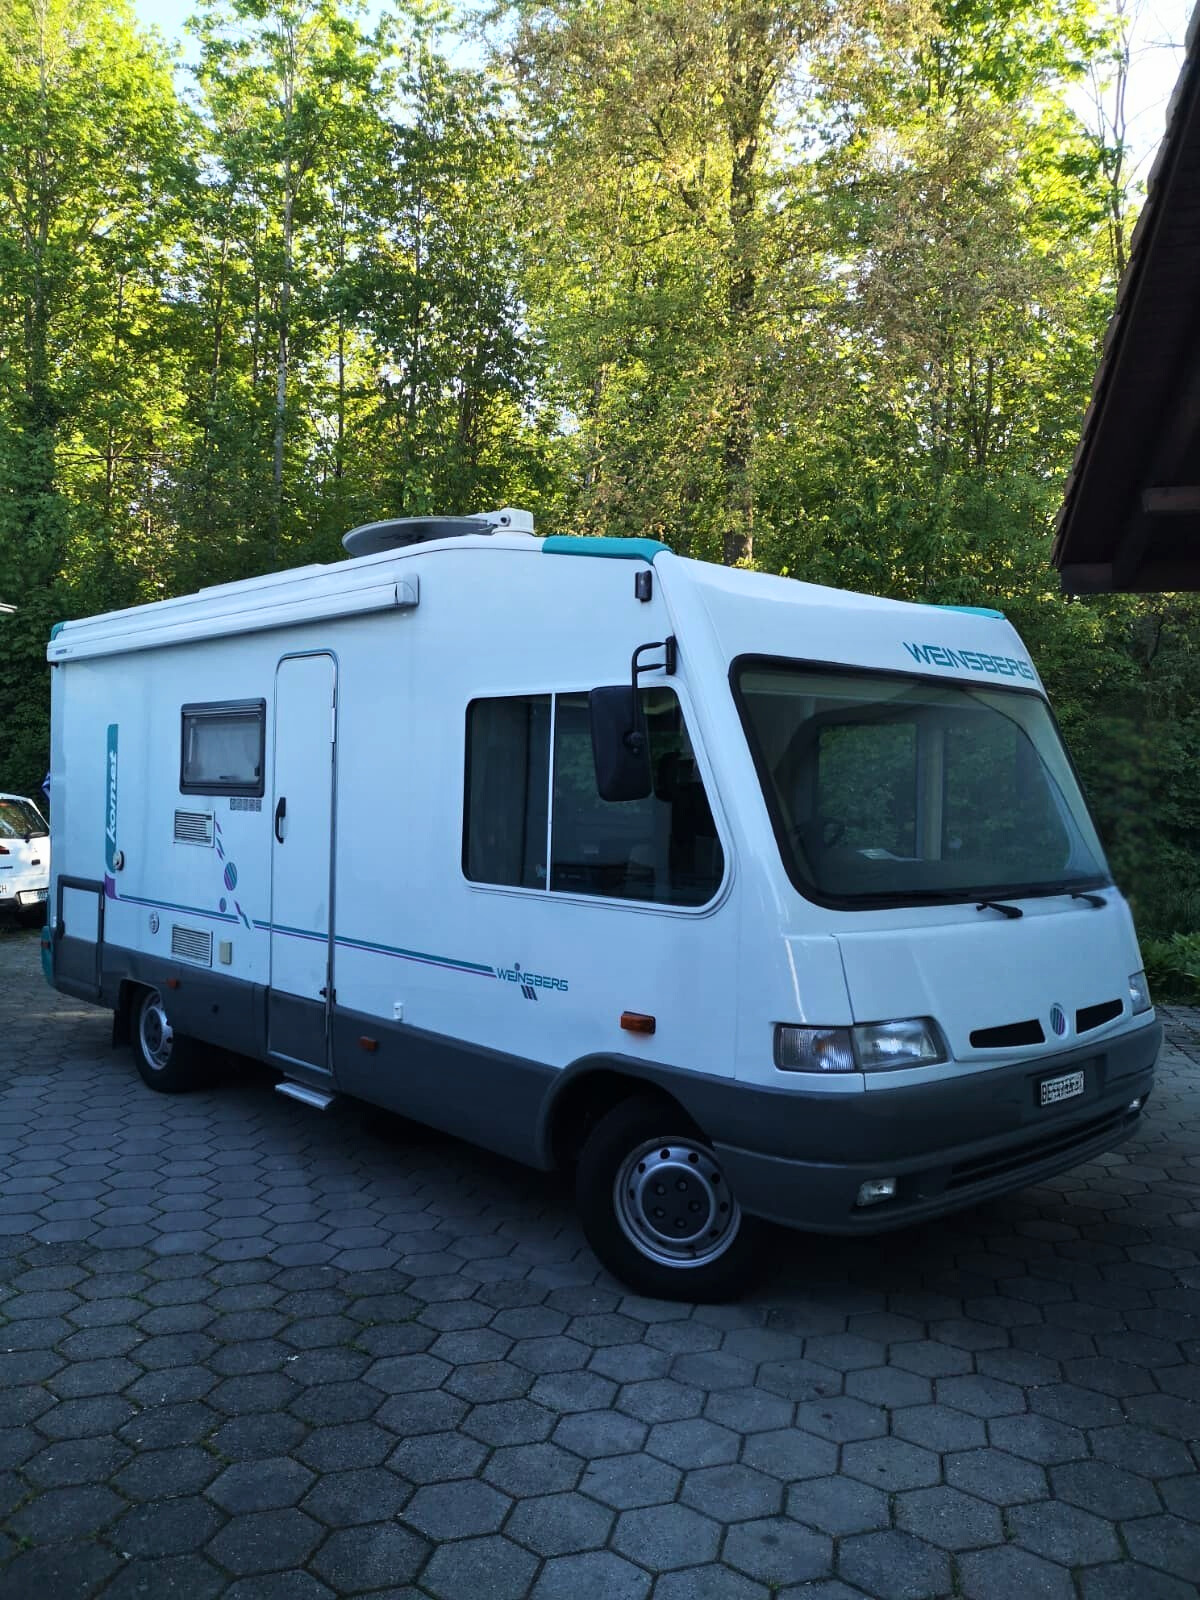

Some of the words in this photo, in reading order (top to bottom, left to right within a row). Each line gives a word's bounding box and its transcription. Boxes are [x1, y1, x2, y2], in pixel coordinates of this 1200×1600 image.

[902, 641, 1035, 680] WEINSBERG
[106, 750, 117, 843] komet
[497, 968, 569, 991] WEINSBERG
